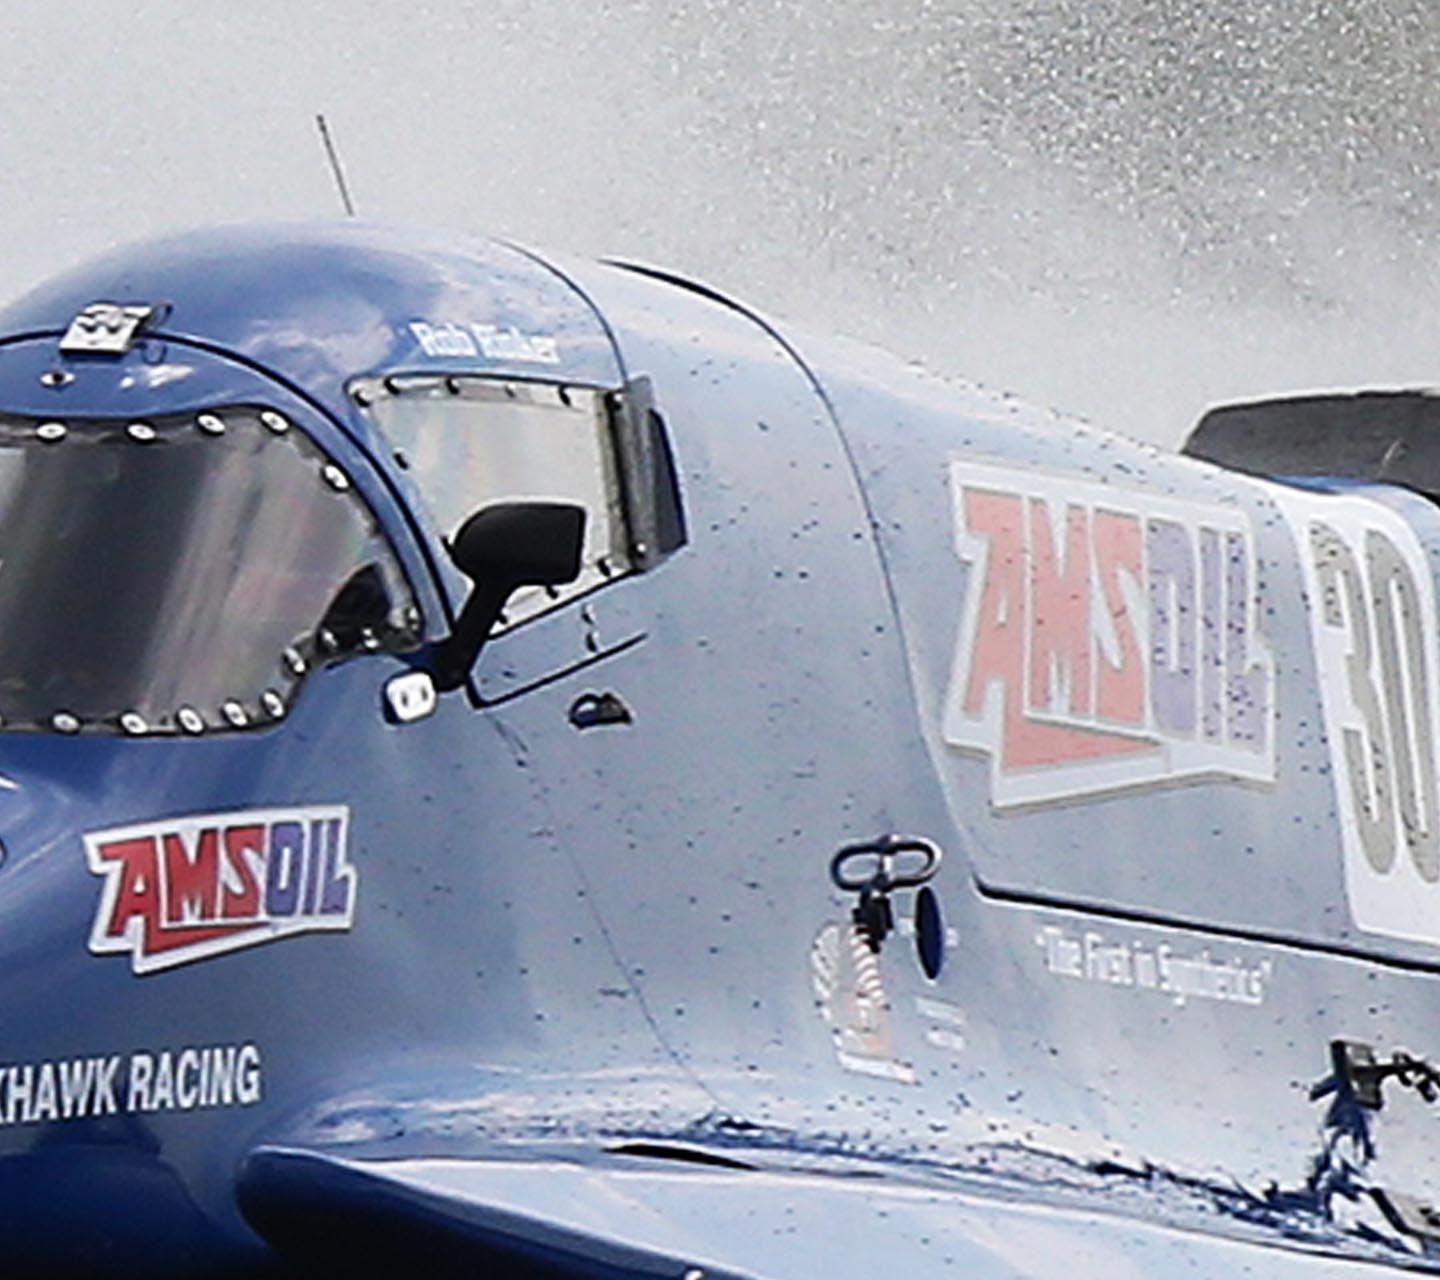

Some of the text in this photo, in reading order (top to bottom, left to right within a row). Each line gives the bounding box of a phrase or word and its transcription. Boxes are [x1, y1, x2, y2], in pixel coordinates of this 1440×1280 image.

[958, 484, 1272, 776] AMSOIL
[96, 817, 353, 956] AMSOIL
[127, 1045, 260, 1112] RACING
